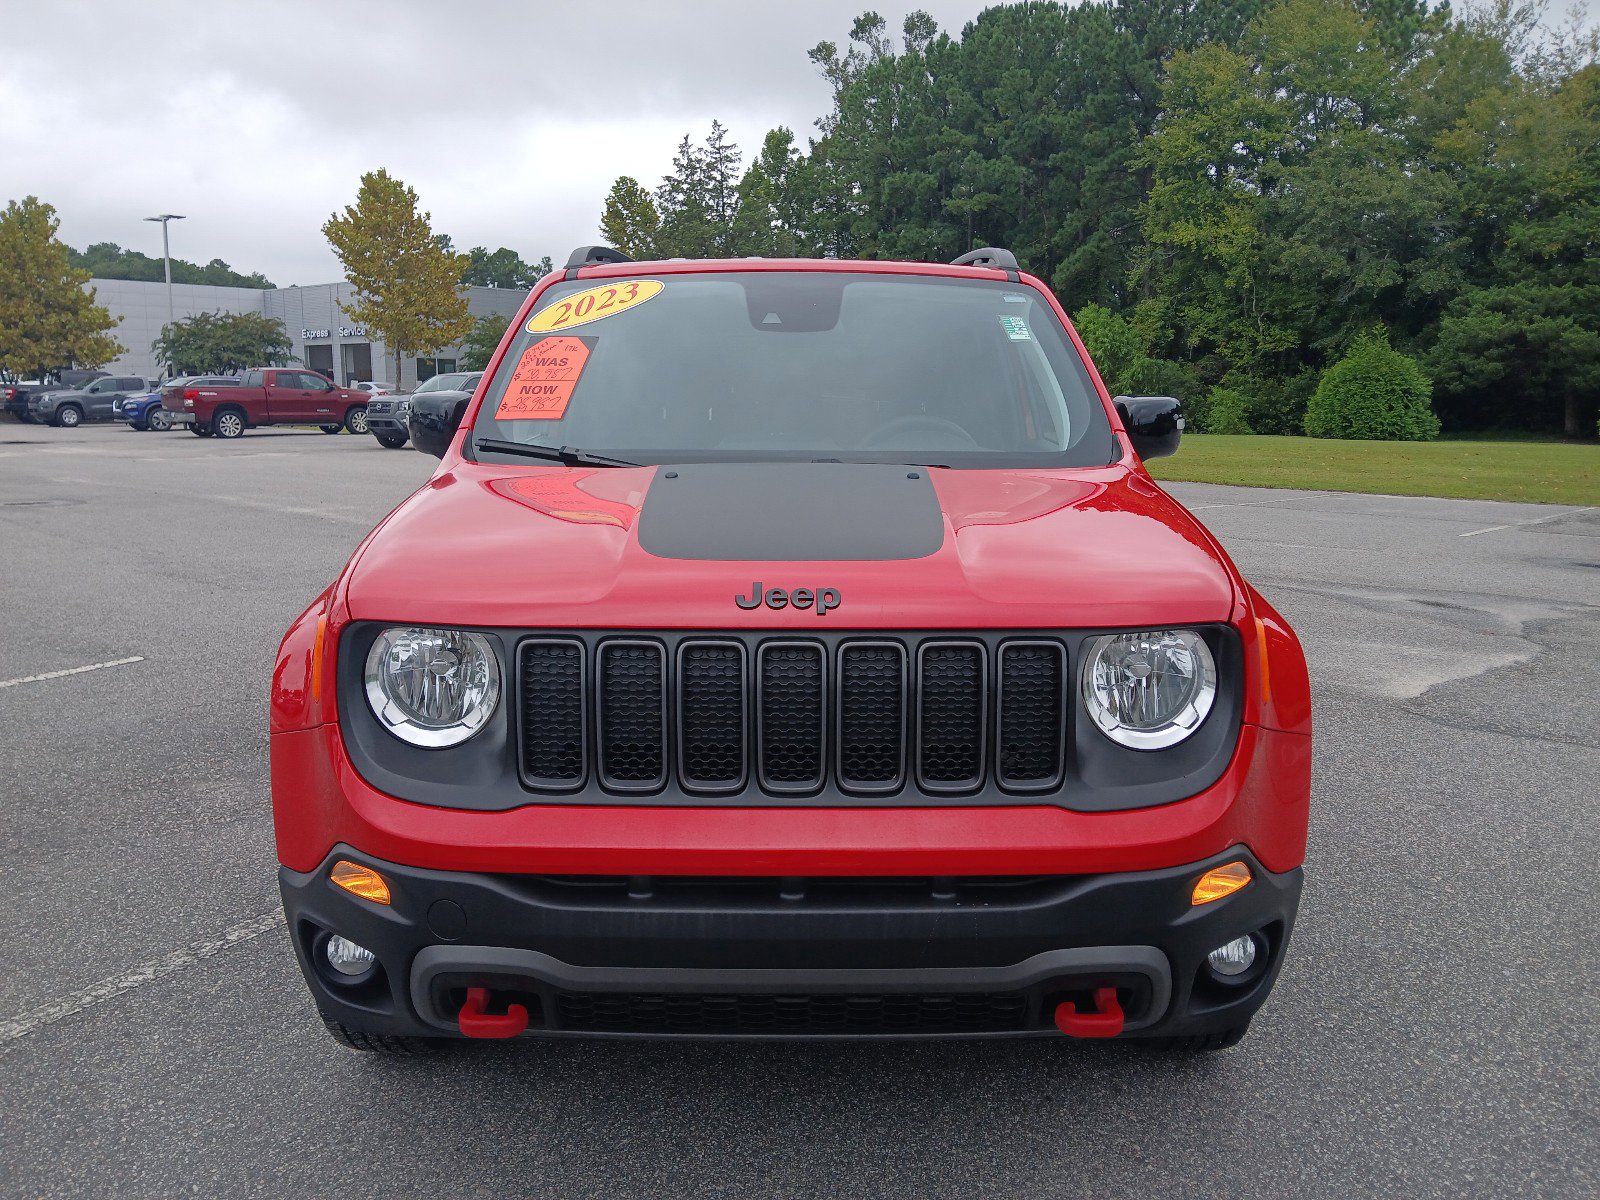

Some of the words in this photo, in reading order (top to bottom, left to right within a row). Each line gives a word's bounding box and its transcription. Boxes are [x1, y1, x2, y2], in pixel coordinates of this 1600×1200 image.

[551, 283, 640, 328] 2023
[301, 328, 329, 340] Express
[338, 326, 366, 337] Service
[535, 357, 569, 367] WAS
[519, 385, 559, 395] NOW
[735, 582, 842, 616] Jeep
